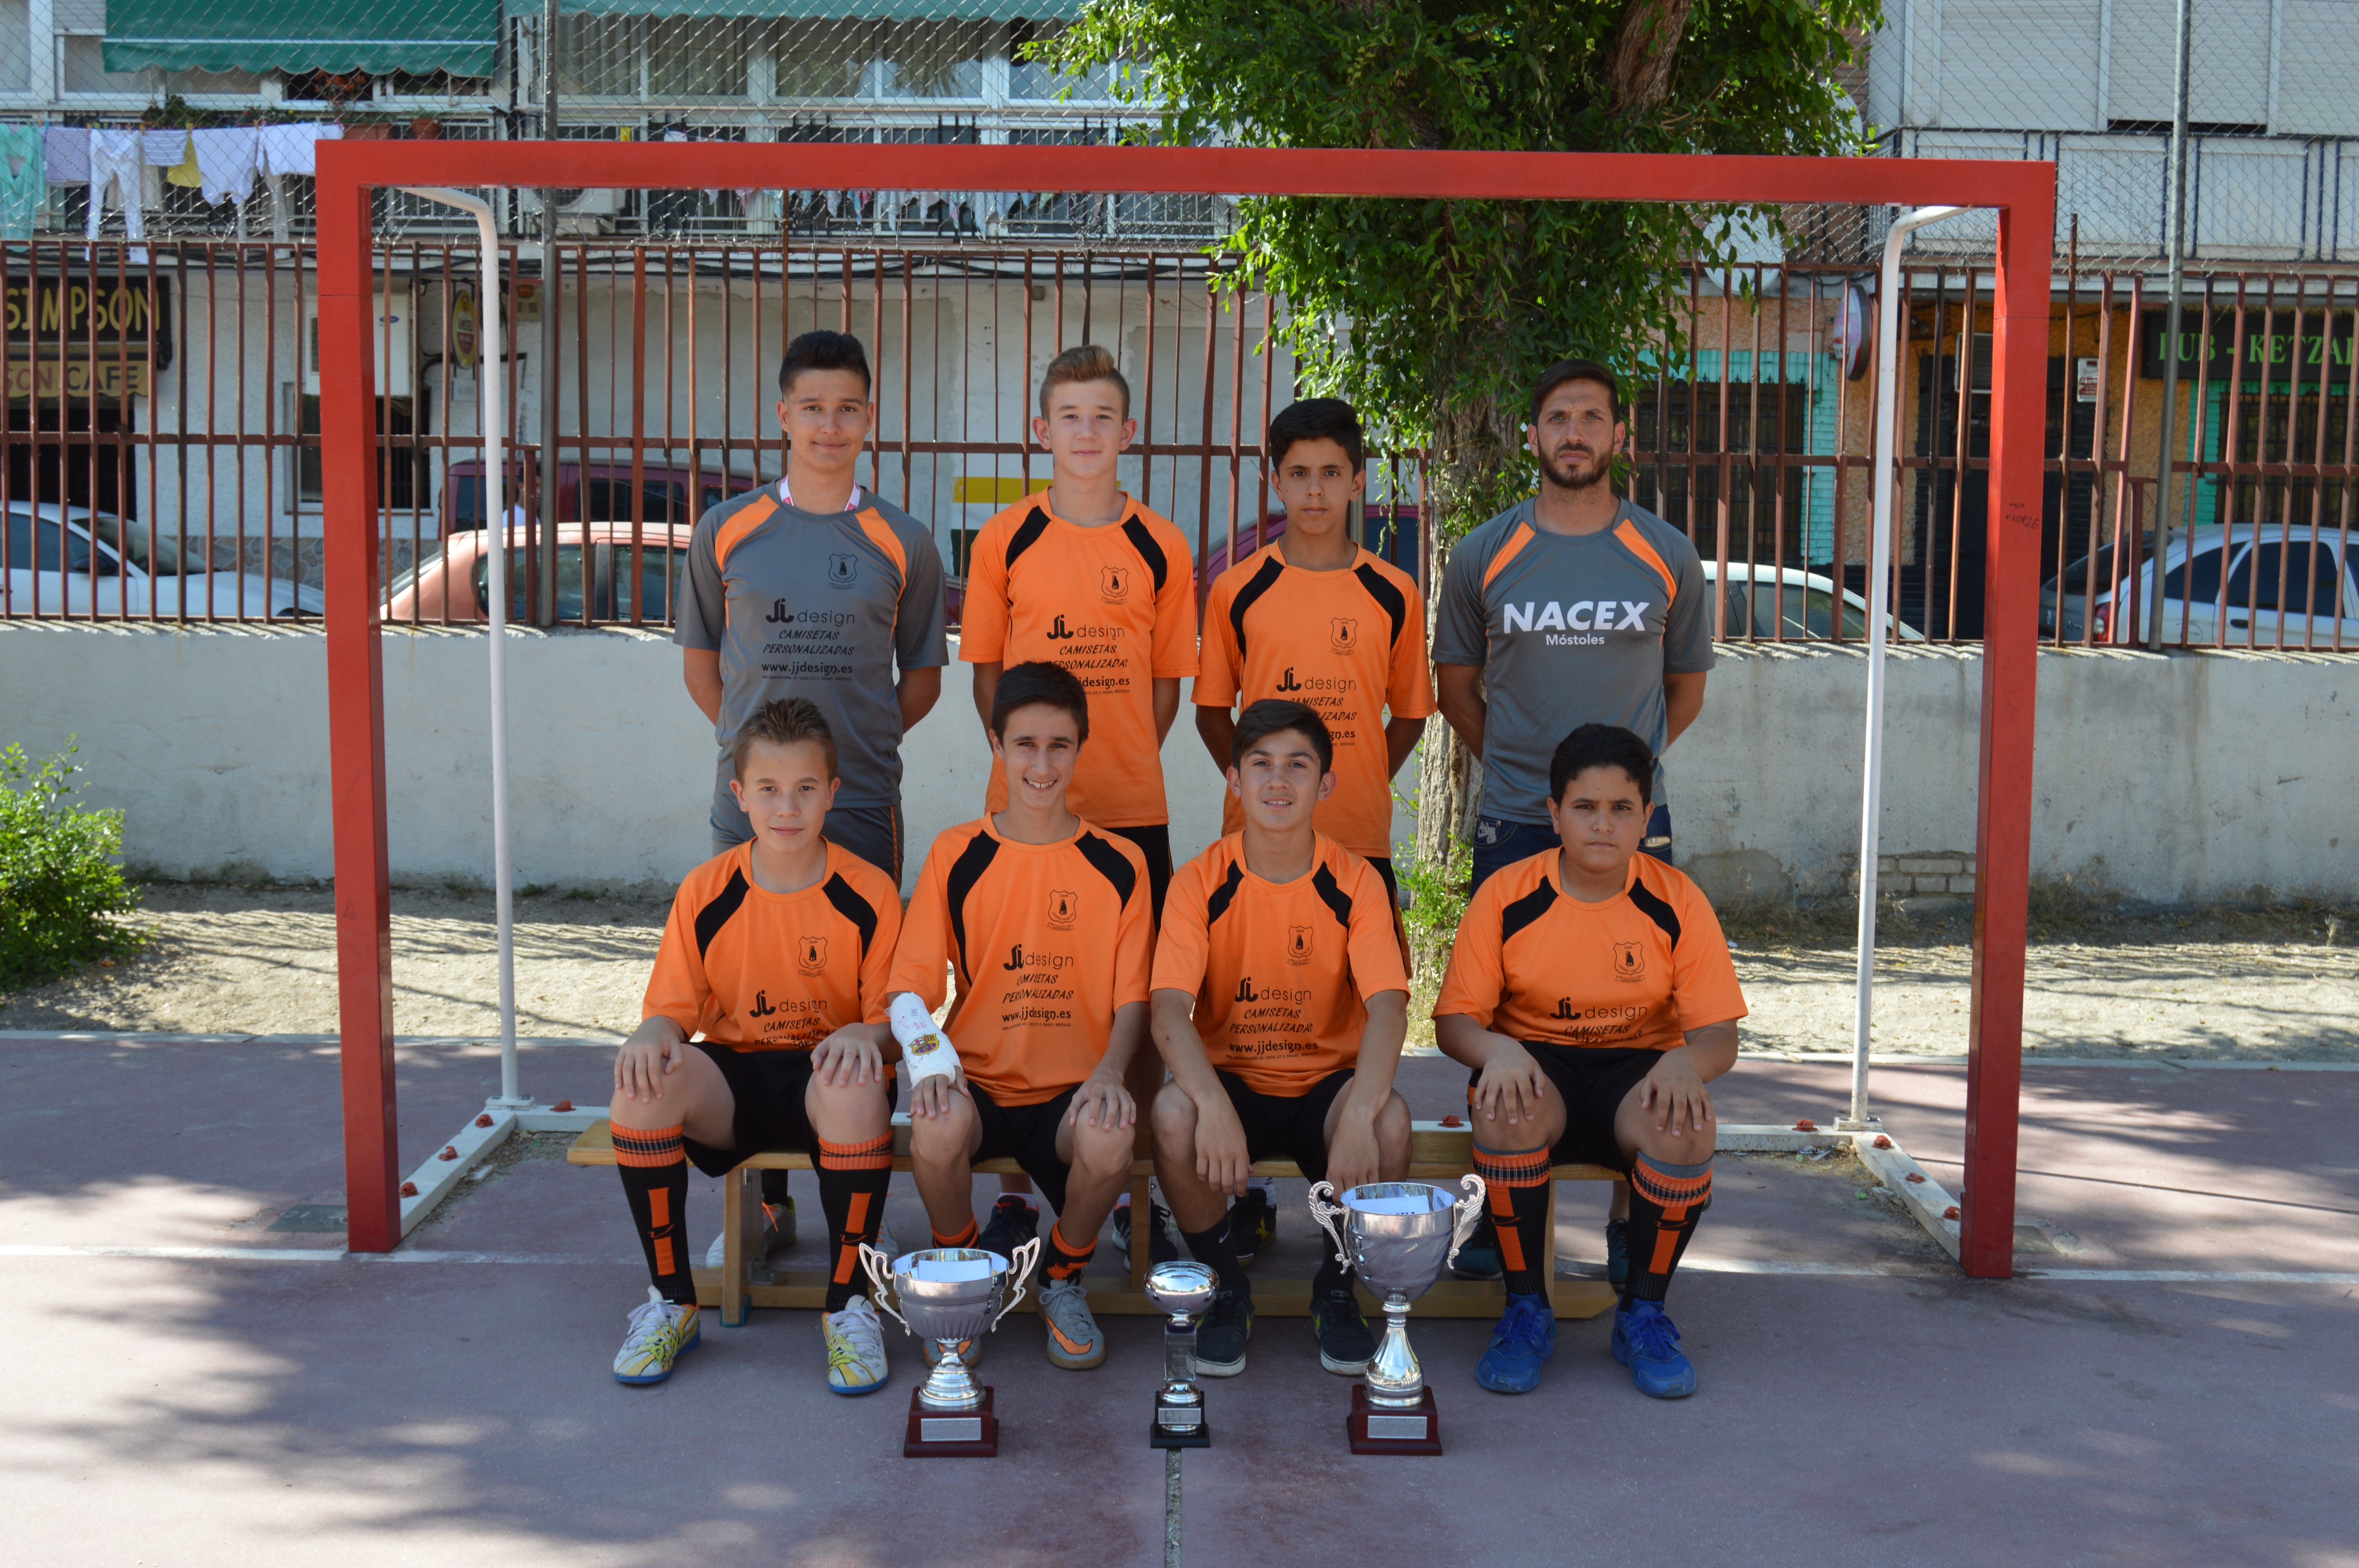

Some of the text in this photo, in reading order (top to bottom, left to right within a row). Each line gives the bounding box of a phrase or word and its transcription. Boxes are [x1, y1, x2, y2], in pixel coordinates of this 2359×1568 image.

[7, 286, 160, 331] SIMPSON
[2005, 514, 2040, 529] PEOPLE
[798, 610, 855, 627] design
[1504, 601, 1650, 634] NACEX
[779, 630, 840, 640] CAMISETAS
[1077, 624, 1125, 640] design
[1546, 633, 1605, 645] Móstoles
[763, 644, 854, 655] PERSONALIZADAS
[1060, 644, 1117, 655] CAMISETAS
[761, 661, 852, 676] www.jjdesign.es
[1305, 677, 1356, 693] design
[1025, 952, 1073, 970] design
[1003, 989, 1074, 1004] PERSONALIZADAS
[1261, 987, 1311, 1005] design
[779, 998, 827, 1013] design
[1244, 1007, 1301, 1019] CAMISETAS
[1585, 1005, 1648, 1021] design
[1002, 1007, 1071, 1022] www.jjdesign.es
[764, 1017, 820, 1033] CAMISETAS
[1230, 1022, 1313, 1034] PERSONALIZADAS
[1565, 1025, 1631, 1035] CAMISETAS
[1229, 1040, 1318, 1055] www.jjdesign.es
